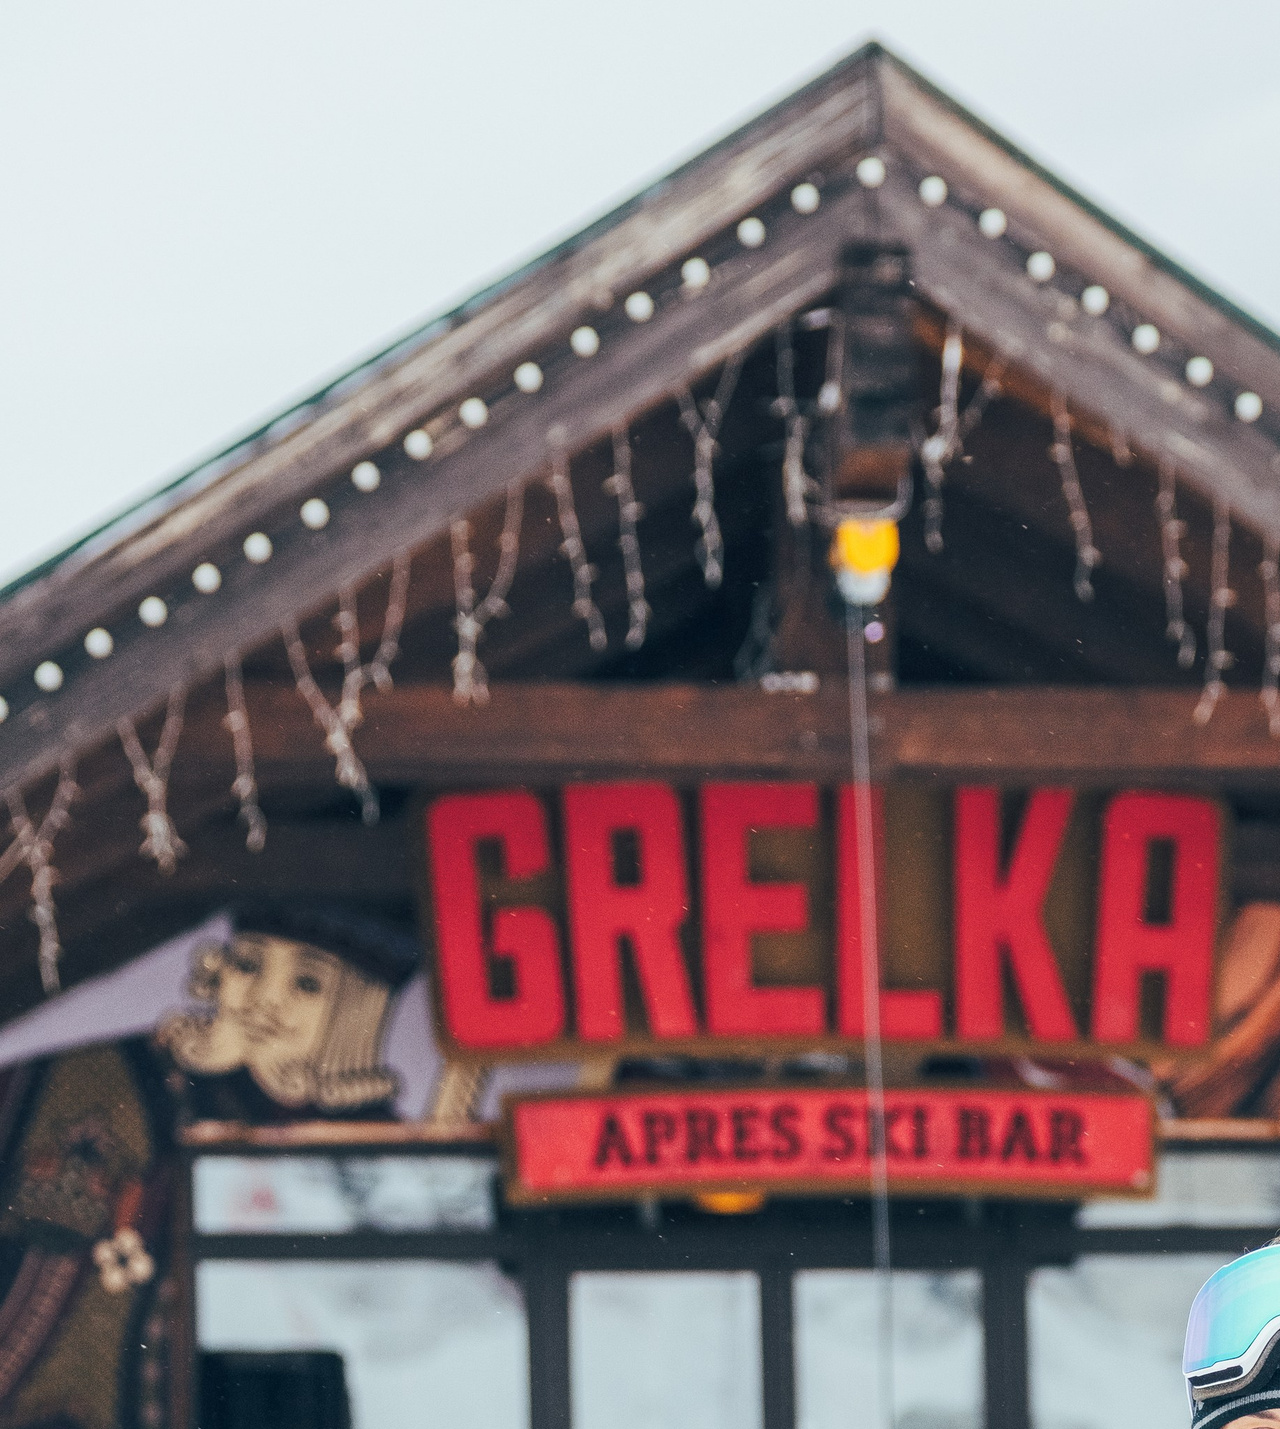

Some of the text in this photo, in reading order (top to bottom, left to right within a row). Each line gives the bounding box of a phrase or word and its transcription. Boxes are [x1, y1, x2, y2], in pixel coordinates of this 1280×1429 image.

[426, 780, 1222, 1049] GRELKA
[594, 1104, 1089, 1170] APRES SKI BAR
